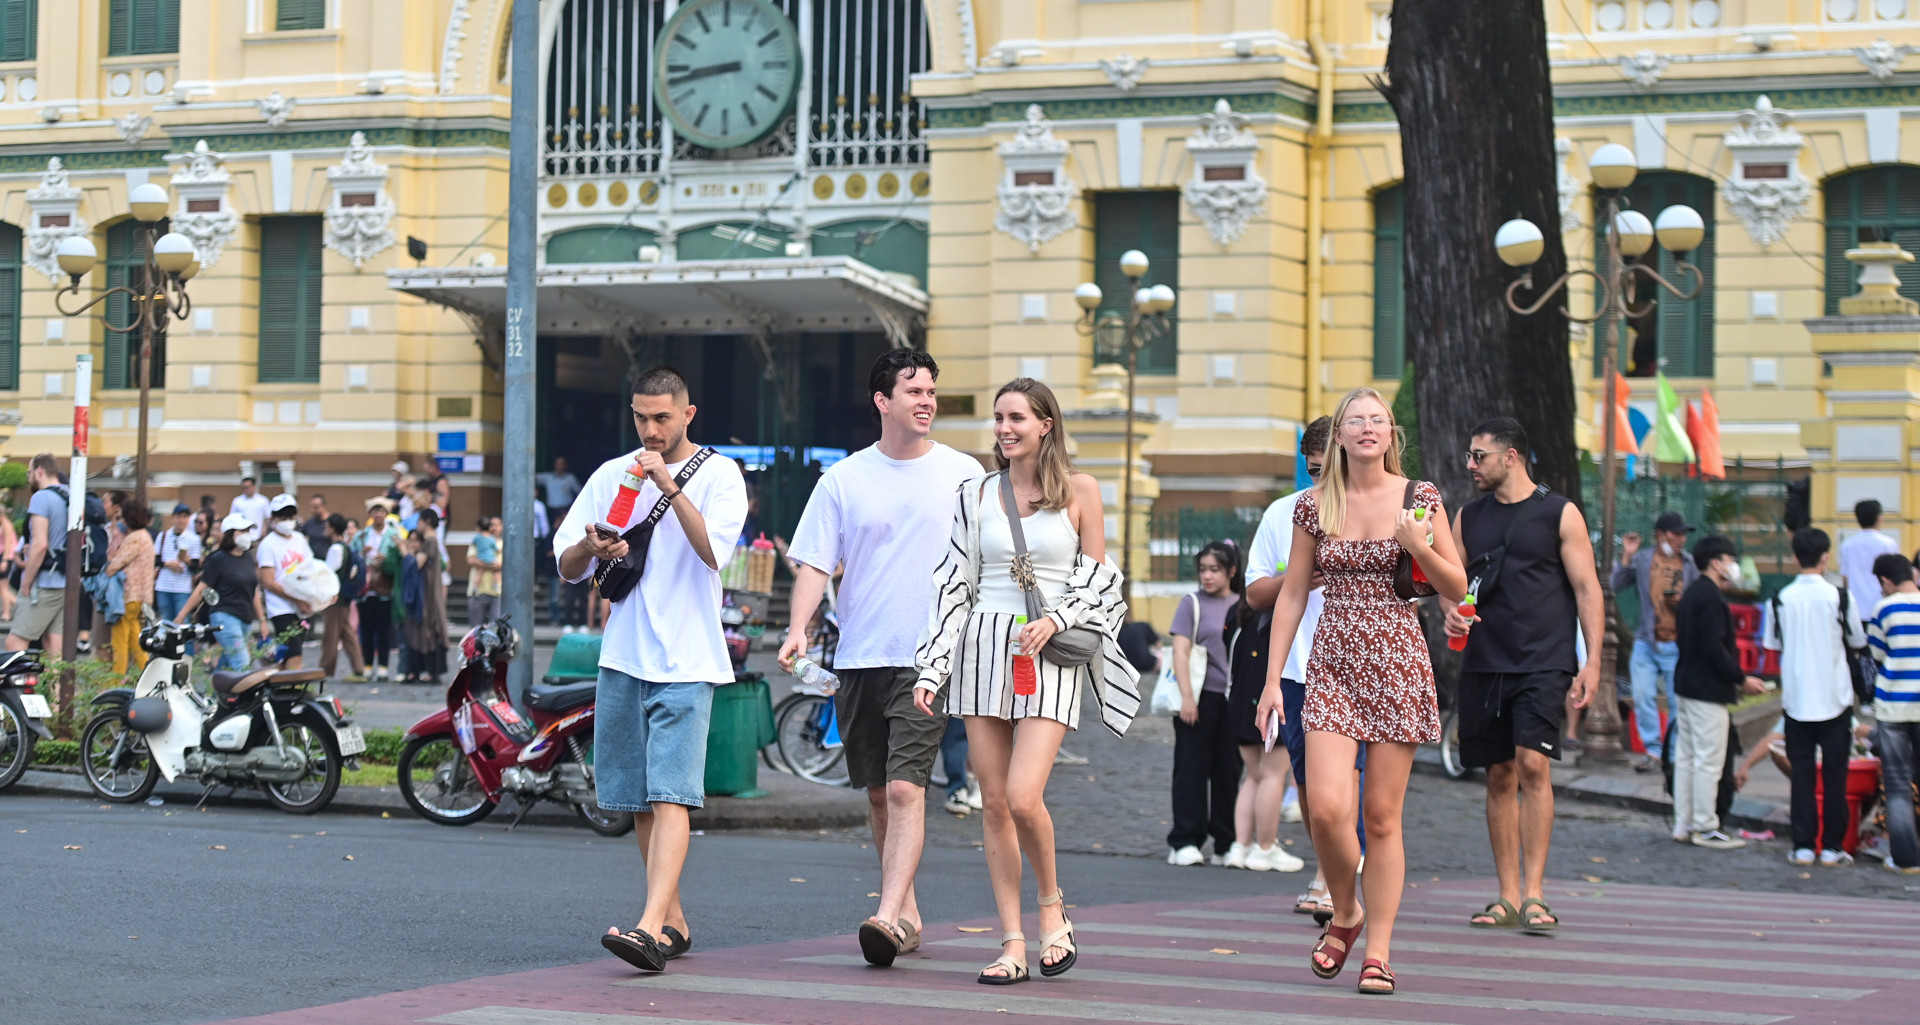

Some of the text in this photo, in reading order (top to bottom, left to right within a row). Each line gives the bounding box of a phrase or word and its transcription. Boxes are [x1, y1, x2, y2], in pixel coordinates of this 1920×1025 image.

[508, 307, 523, 323] CV
[508, 326, 521, 341] 31
[508, 342, 523, 357] 32
